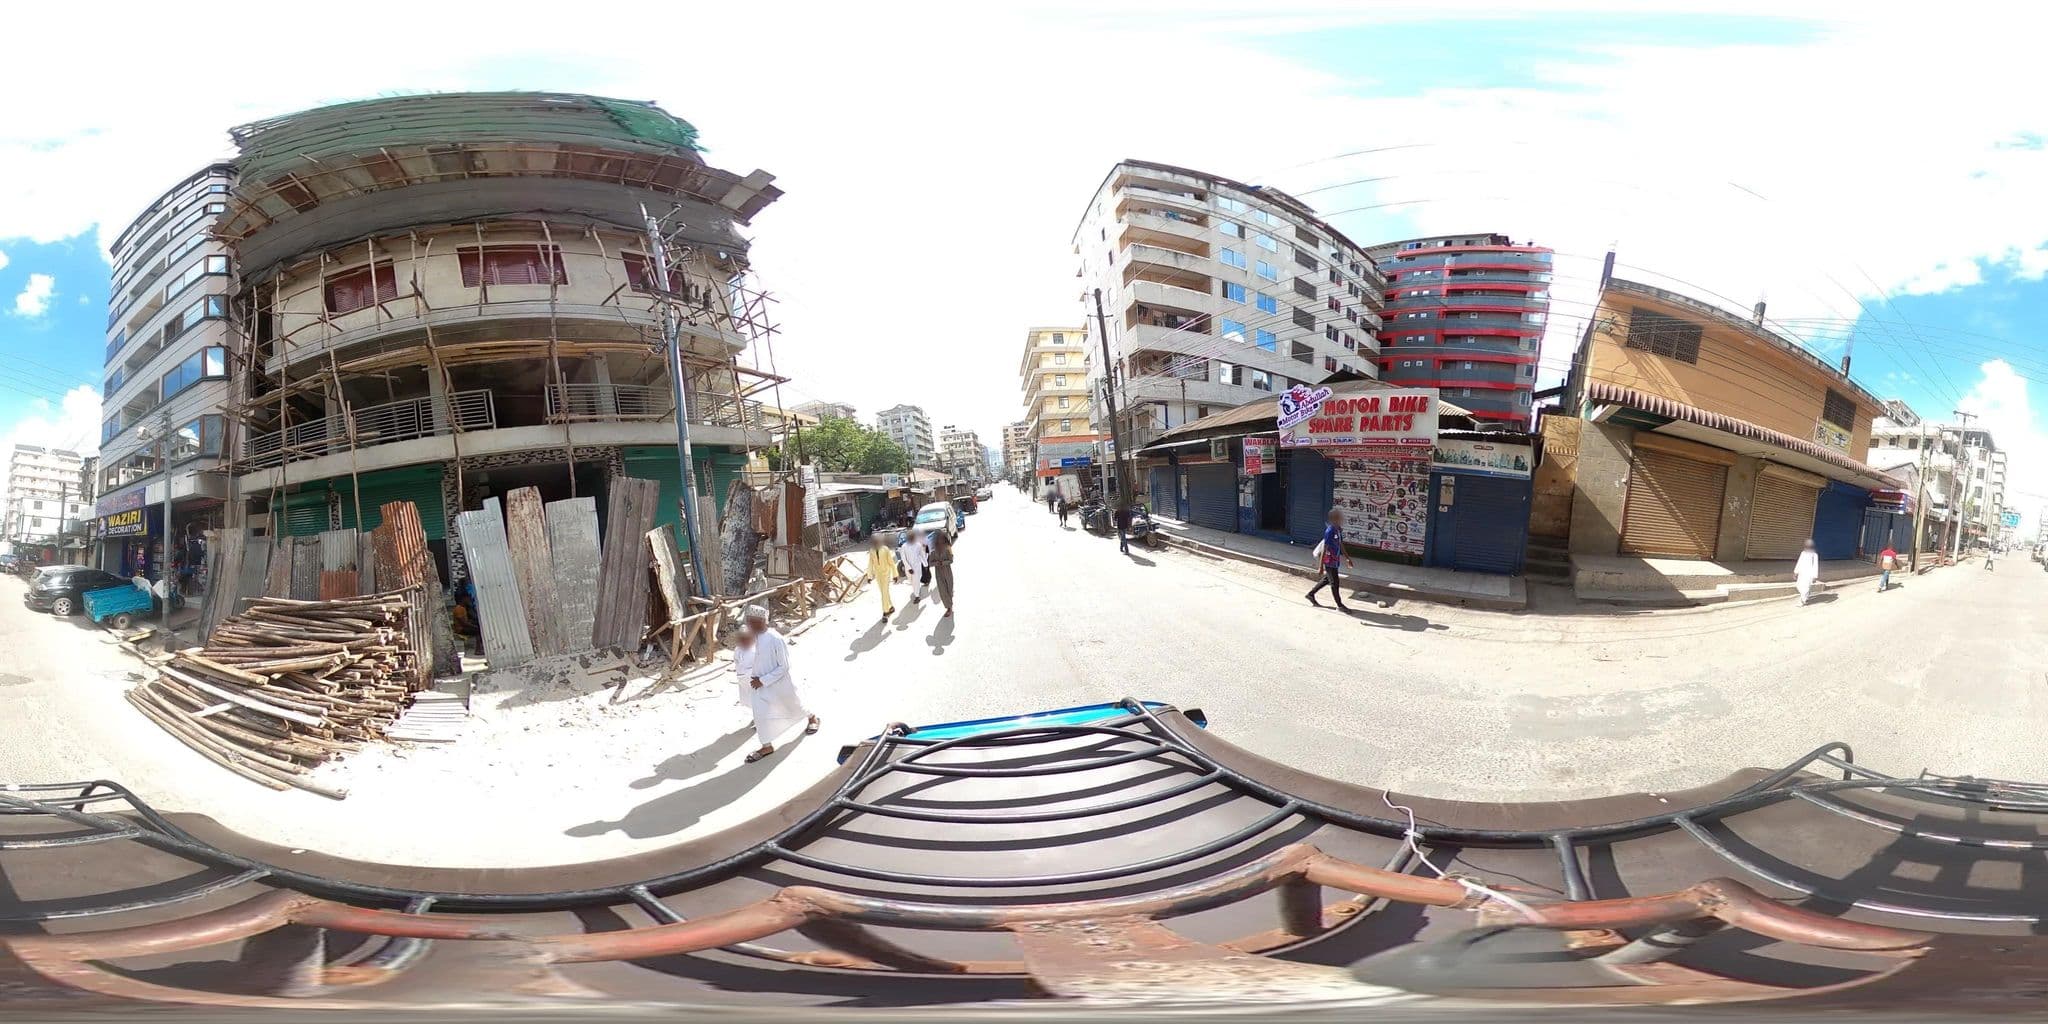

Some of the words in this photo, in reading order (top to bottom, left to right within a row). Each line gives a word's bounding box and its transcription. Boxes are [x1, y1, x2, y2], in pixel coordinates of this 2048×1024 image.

[1301, 388, 1330, 409] Abdullah
[1324, 397, 1380, 416] MOTOR
[1388, 396, 1429, 413] BIKE
[1282, 413, 1299, 425] Motor
[1300, 405, 1313, 417] Bike
[1308, 416, 1354, 433] SPARE
[1360, 414, 1414, 432] PARTS
[108, 510, 141, 527] WAZIRI
[108, 524, 142, 535] DECORATION
